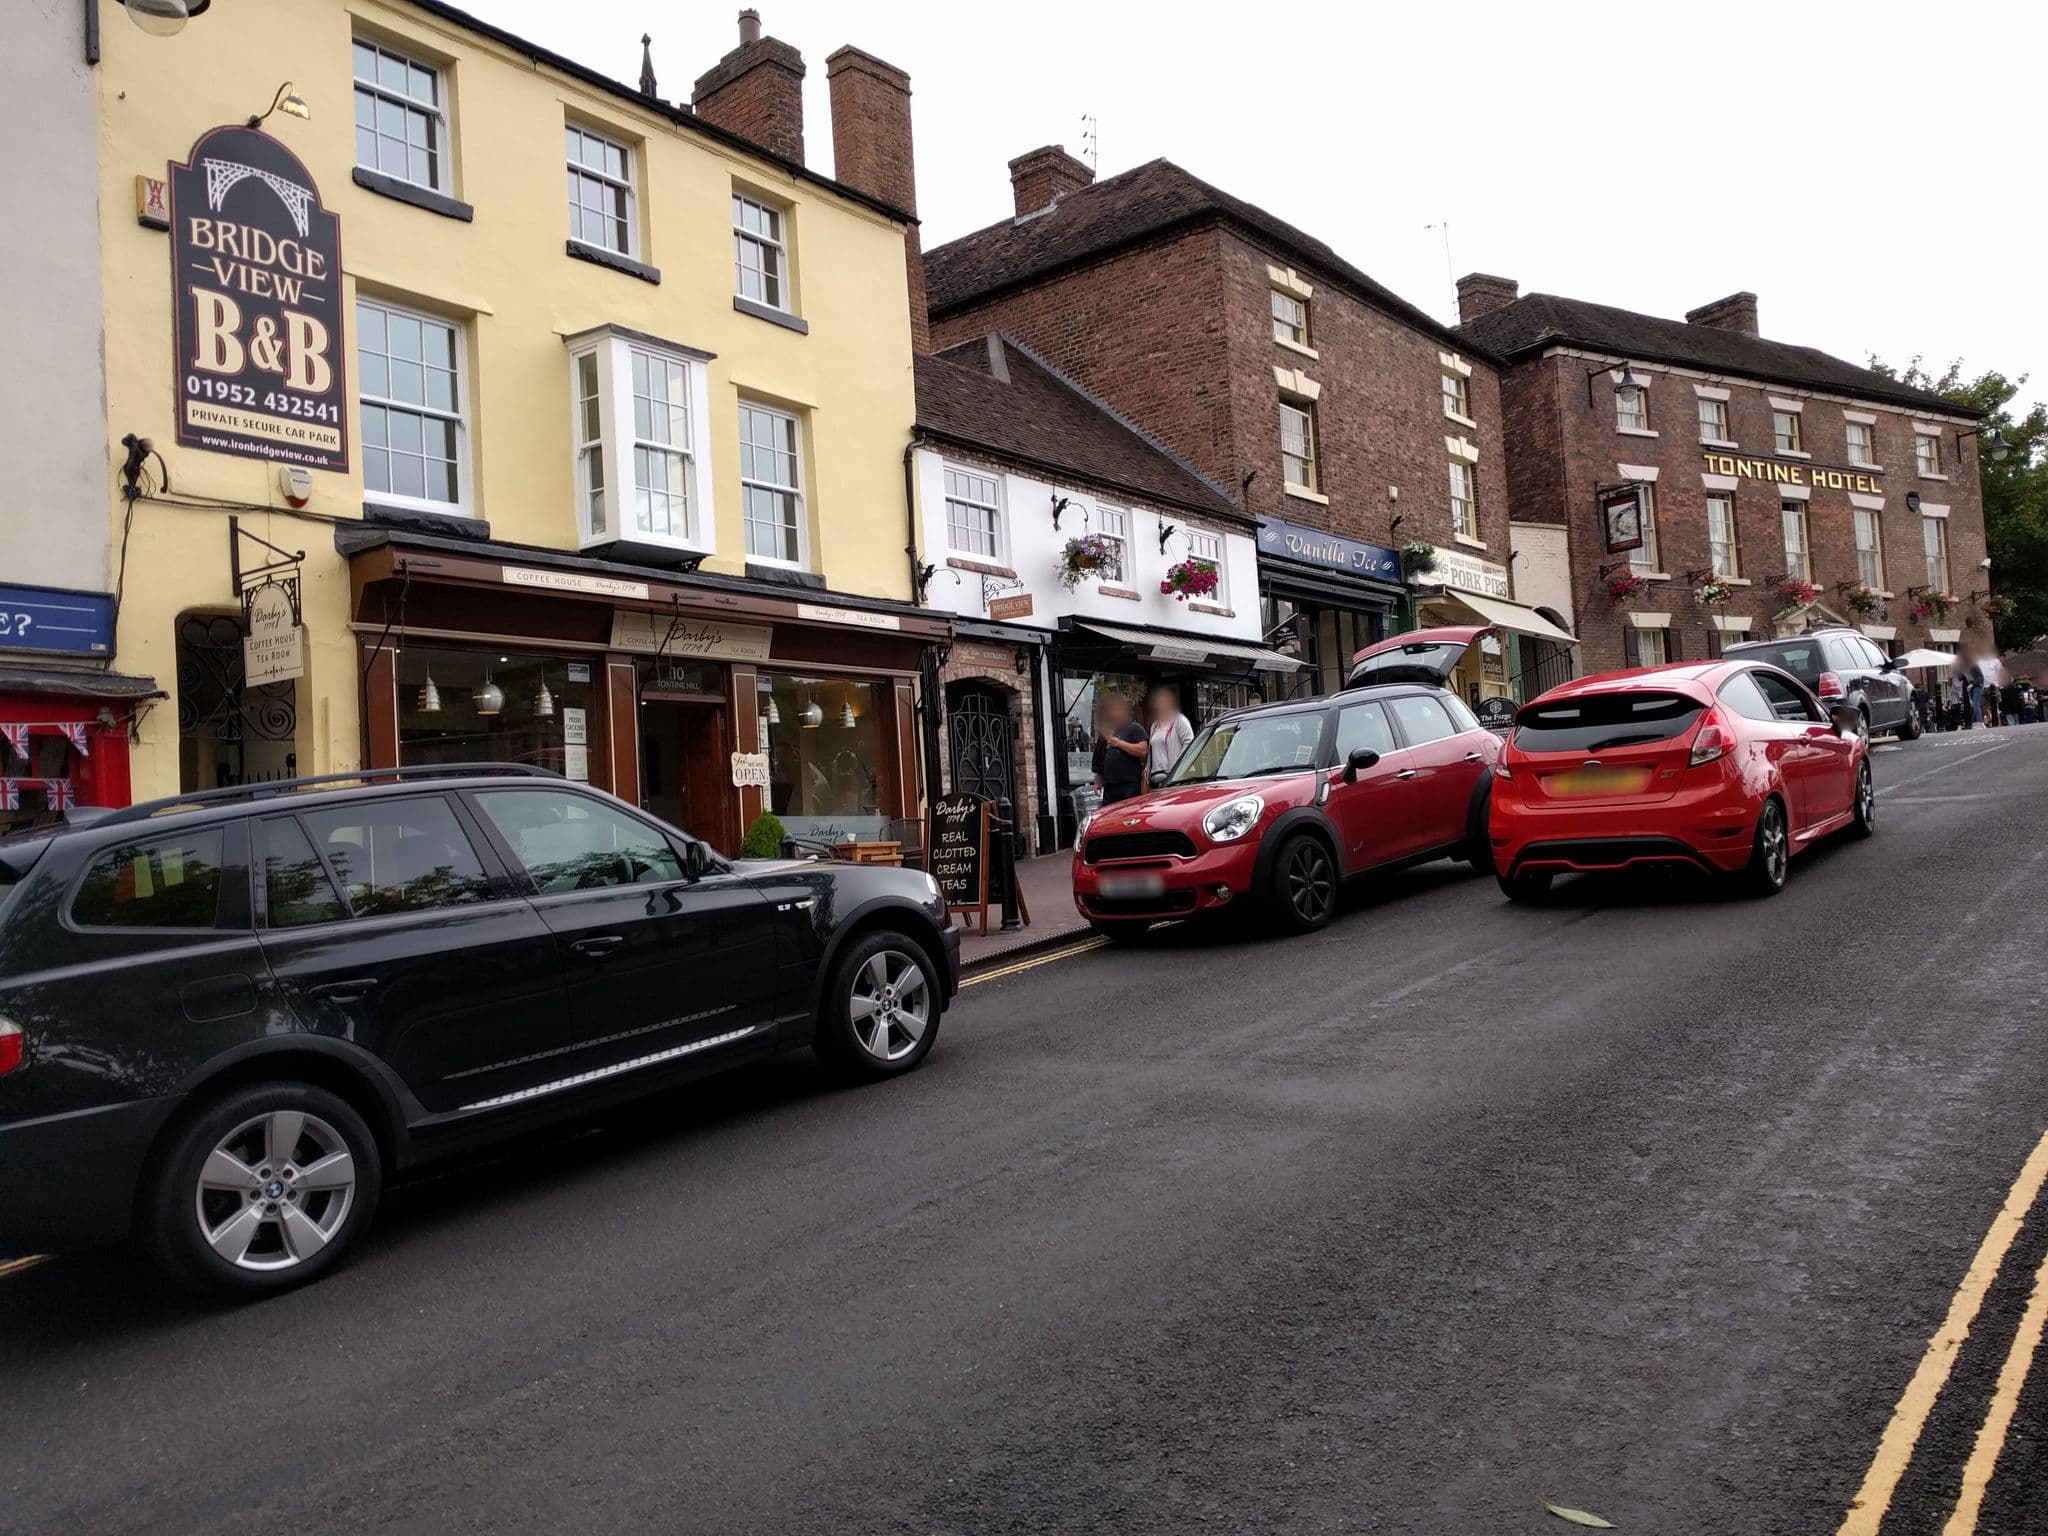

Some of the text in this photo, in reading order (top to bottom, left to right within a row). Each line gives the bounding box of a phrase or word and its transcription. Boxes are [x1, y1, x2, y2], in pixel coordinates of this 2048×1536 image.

[189, 217, 328, 281] BRIDGE
[211, 257, 304, 305] VIEW
[188, 284, 334, 395] B&B
[187, 375, 338, 423] 01952 432541
[191, 408, 337, 445] PRIVATE SECURE CAR PARK
[201, 435, 329, 465] www.ironbridgeview.co.uk
[1703, 454, 1883, 493] TONTINE HOTEL
[1286, 534, 1377, 571] Vanilla Ice
[517, 572, 551, 584] COFFEE
[554, 578, 581, 588] HOUSE
[1450, 567, 1482, 592] PORK
[1484, 576, 1507, 598] PIES
[254, 600, 288, 629] Darby's
[250, 633, 296, 651] COFFEE HOUSE
[670, 622, 724, 653] Darby's
[681, 642, 704, 653] 1774
[257, 650, 291, 664] TEA ROOM
[672, 667, 685, 680] 10
[657, 680, 700, 691] TONTINE HILL
[1481, 714, 1493, 722] The
[935, 798, 977, 822] Darby's
[809, 824, 846, 845] Darby's
[941, 831, 968, 843] REAL
[933, 847, 976, 859] CLOTTED
[937, 863, 972, 874] CREAM
[940, 879, 967, 890] TEAS
